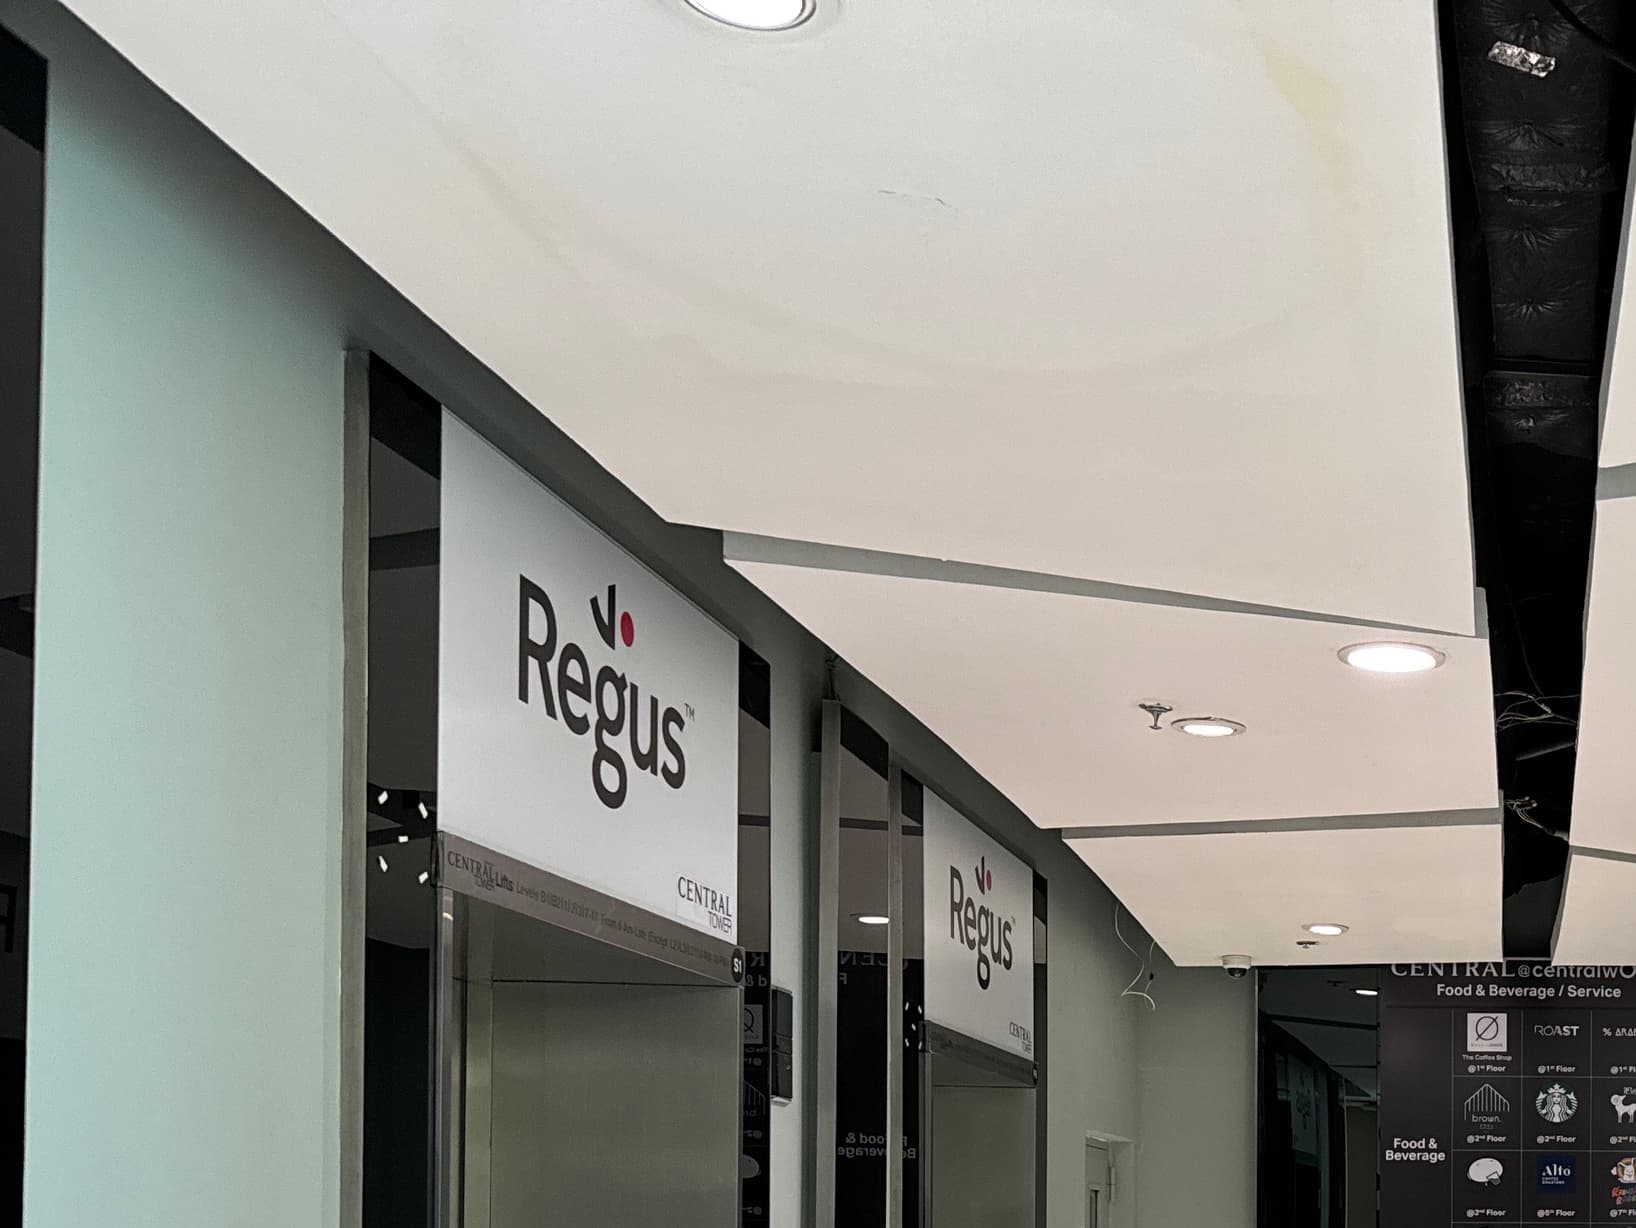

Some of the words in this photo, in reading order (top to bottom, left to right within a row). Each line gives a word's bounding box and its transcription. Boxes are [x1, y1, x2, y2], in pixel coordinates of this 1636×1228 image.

[518, 573, 686, 809] Regus
[447, 851, 495, 883] CENTRAL
[678, 876, 732, 917] CENTRAL
[708, 910, 732, 934] TOWER
[949, 865, 1013, 990] Regus
[733, 957, 742, 973] S1
[1436, 983, 1472, 996] Food
[1475, 984, 1486, 996] &
[1489, 984, 1555, 999] Beverage
[1567, 985, 1621, 998] Service
[1534, 1025, 1579, 1036] ROAST
[1496, 1054, 1512, 1062] Shop
[1393, 1138, 1426, 1149] Food
[1428, 1138, 1438, 1149] &
[1385, 1150, 1446, 1163] Beverage
[1542, 1164, 1571, 1176] Alto
